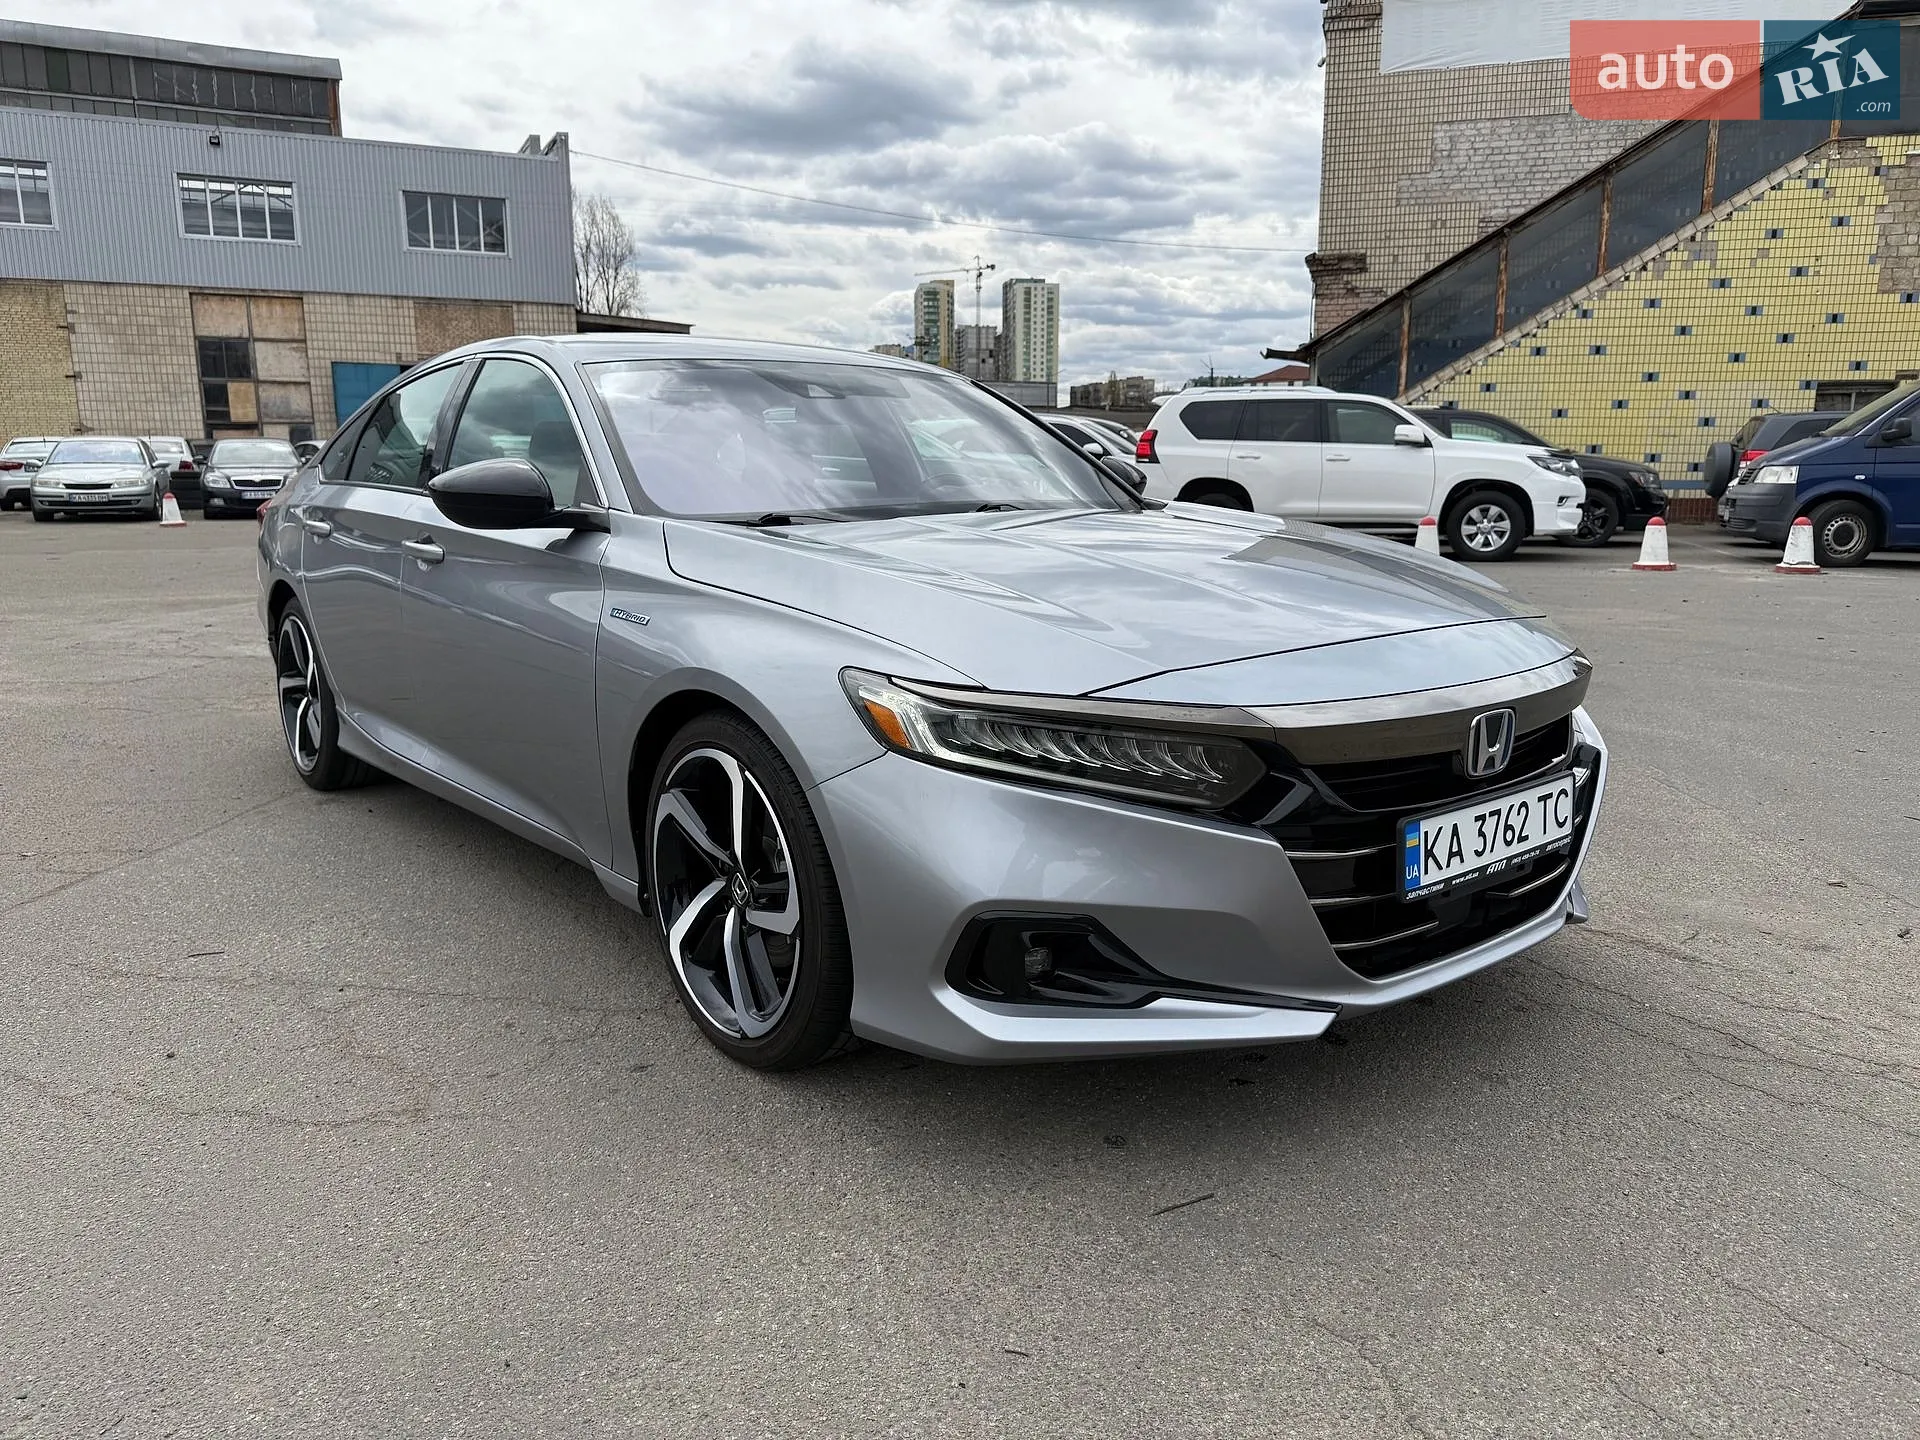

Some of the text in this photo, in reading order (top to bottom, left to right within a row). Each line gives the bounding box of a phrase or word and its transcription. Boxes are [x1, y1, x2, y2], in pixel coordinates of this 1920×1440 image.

[1423, 788, 1569, 876] KA 3762 TC
[1405, 864, 1419, 880] UA
